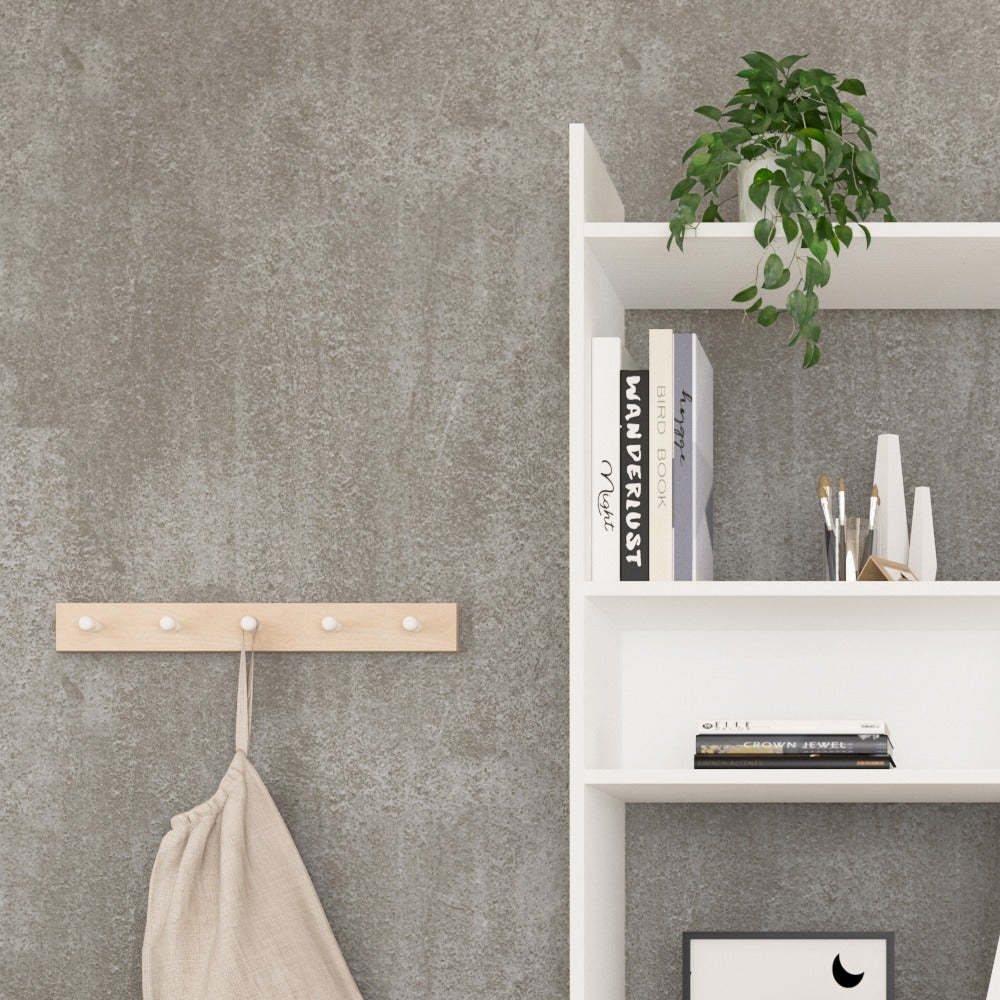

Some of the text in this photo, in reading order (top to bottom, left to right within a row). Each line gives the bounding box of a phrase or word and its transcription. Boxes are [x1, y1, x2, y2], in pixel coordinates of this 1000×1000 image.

[625, 375, 642, 568] WANDERLUST
[657, 386, 667, 509] BIRD BOOK
[802, 741, 846, 749] JEWEL
